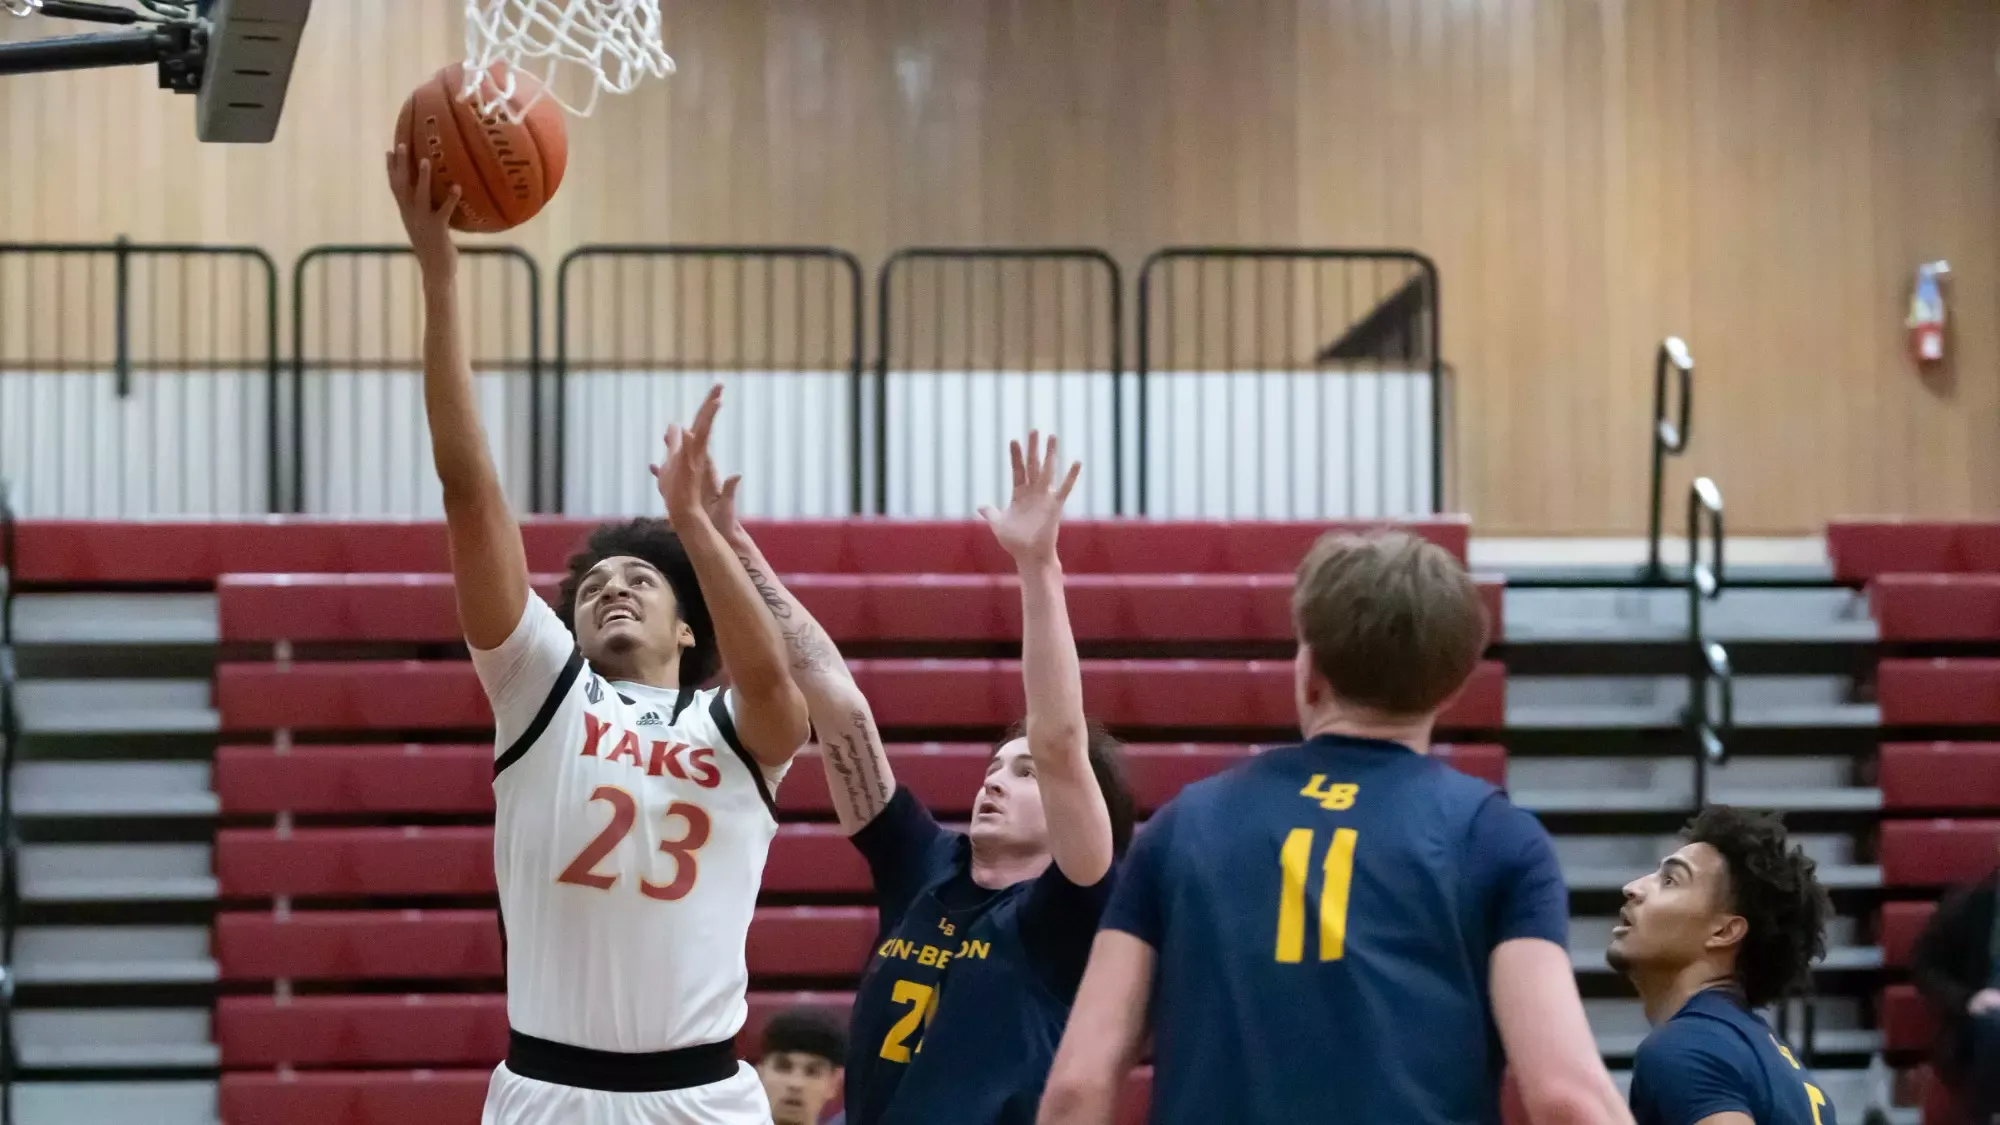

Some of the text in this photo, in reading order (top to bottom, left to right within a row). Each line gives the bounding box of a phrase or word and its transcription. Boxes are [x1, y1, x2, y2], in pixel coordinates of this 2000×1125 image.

[580, 711, 722, 789] YAKS
[1300, 773, 1360, 811] LB
[556, 784, 712, 902] 23
[937, 917, 956, 937] LB
[1275, 827, 1358, 963] 11
